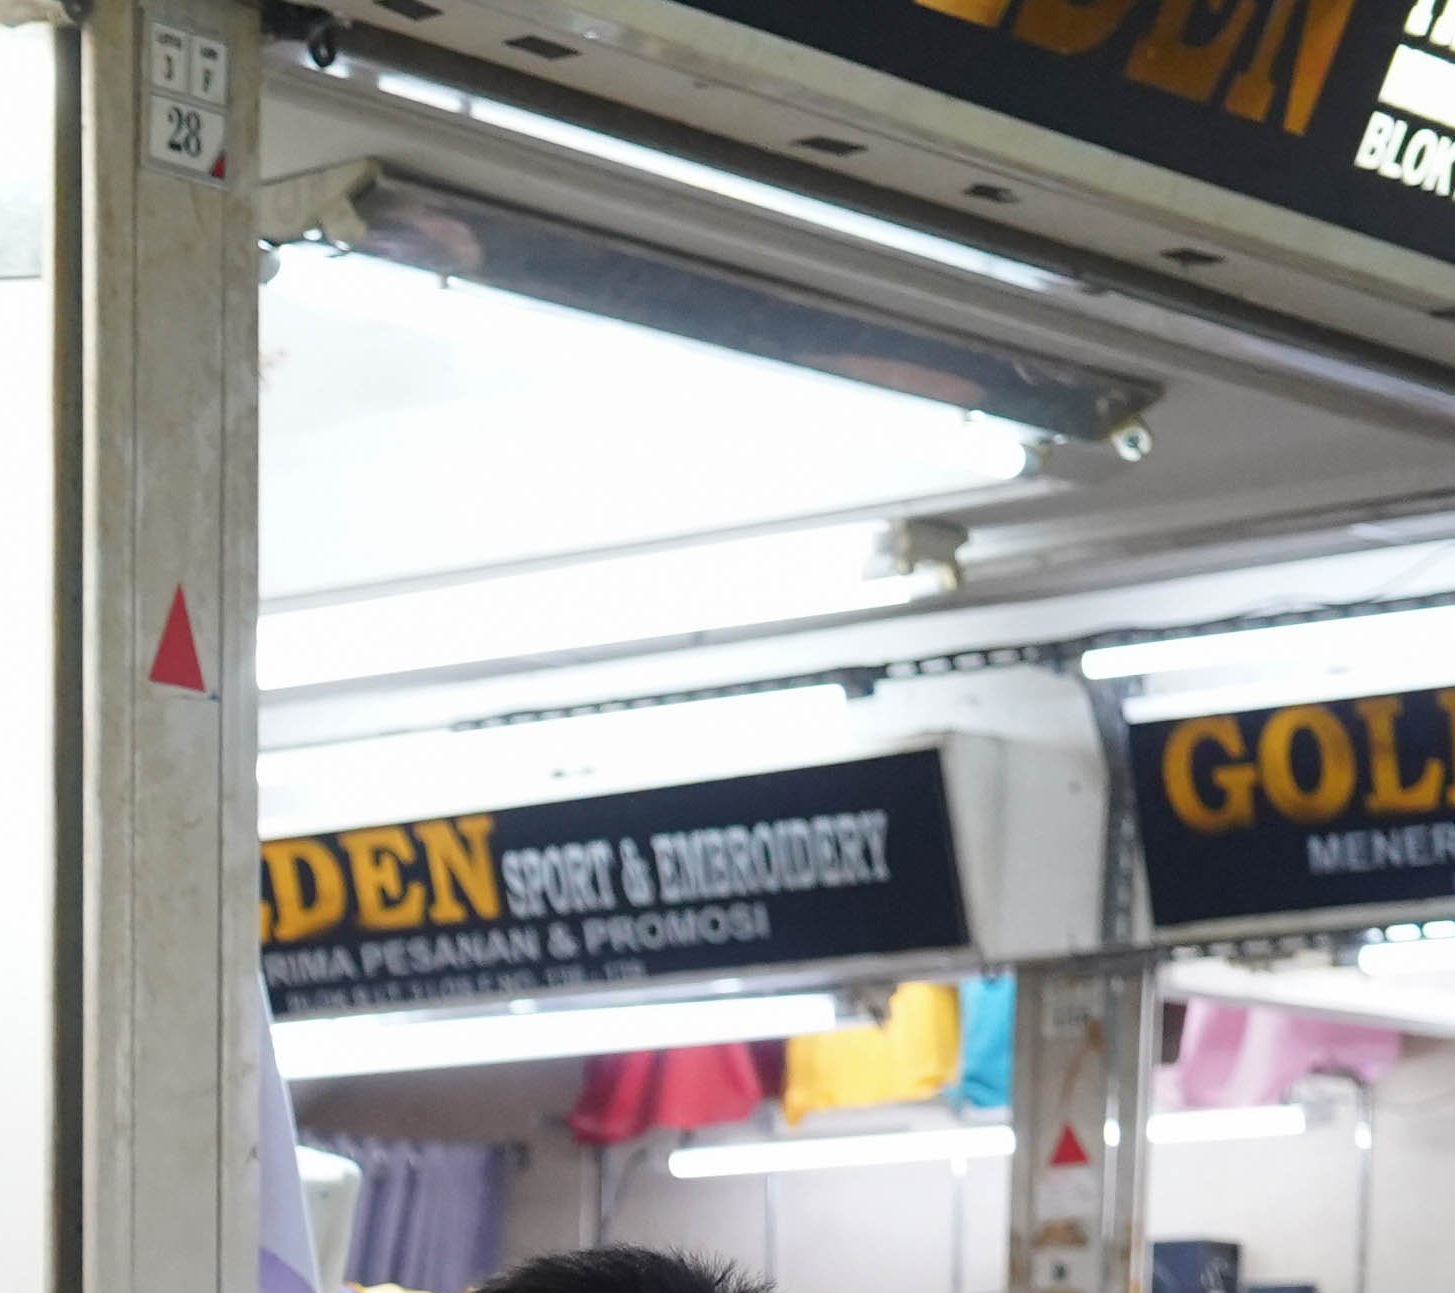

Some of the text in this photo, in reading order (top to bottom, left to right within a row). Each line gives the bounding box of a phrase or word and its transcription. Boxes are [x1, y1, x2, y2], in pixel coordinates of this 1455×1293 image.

[167, 106, 202, 158] 28
[1162, 687, 1455, 836] GOL
[260, 809, 891, 946] DEN SPORT & EMBROIDERY
[361, 925, 541, 978] PESANAN
[546, 922, 578, 959] &
[582, 903, 772, 954] PROMOSI
